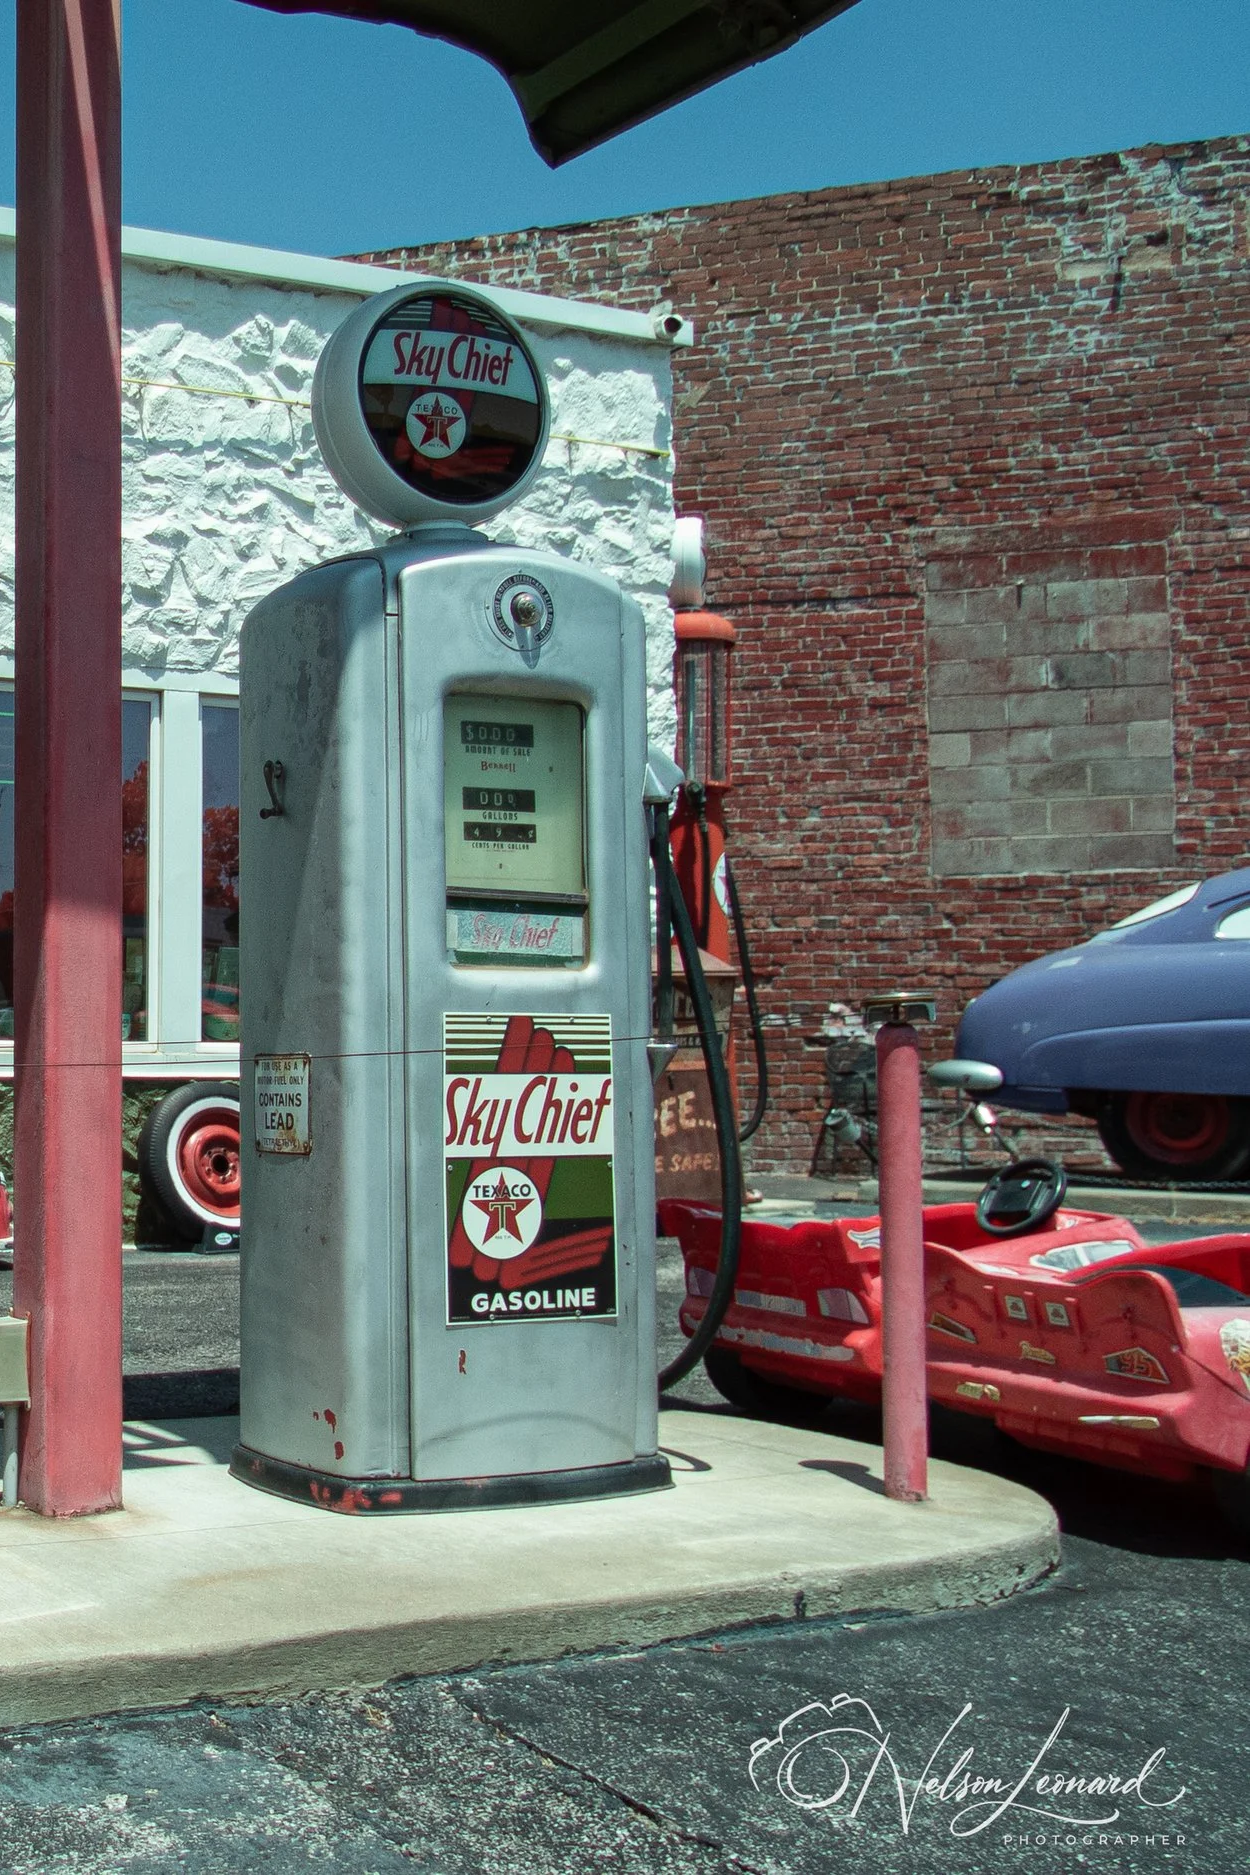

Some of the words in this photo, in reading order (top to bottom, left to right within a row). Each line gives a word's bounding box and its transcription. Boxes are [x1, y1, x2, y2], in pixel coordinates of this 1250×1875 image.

[393, 331, 445, 384] Sky
[447, 335, 514, 386] Chief
[465, 745, 497, 755] AMOUNT
[500, 747, 510, 756] OF
[513, 747, 531, 757] SALE
[482, 811, 518, 821] GALLONS
[509, 910, 560, 950] Chief
[284, 1060, 291, 1071] AS
[293, 1060, 298, 1071] A
[274, 1075, 287, 1086] FUEL
[289, 1075, 304, 1086] ONLY
[259, 1092, 303, 1108] CONTAINS
[264, 1112, 295, 1131] LEAD
[446, 1077, 512, 1157] Sky
[513, 1075, 612, 1144] Chief
[472, 1183, 531, 1199] TEXACO
[470, 1287, 596, 1314] GASOLINE
